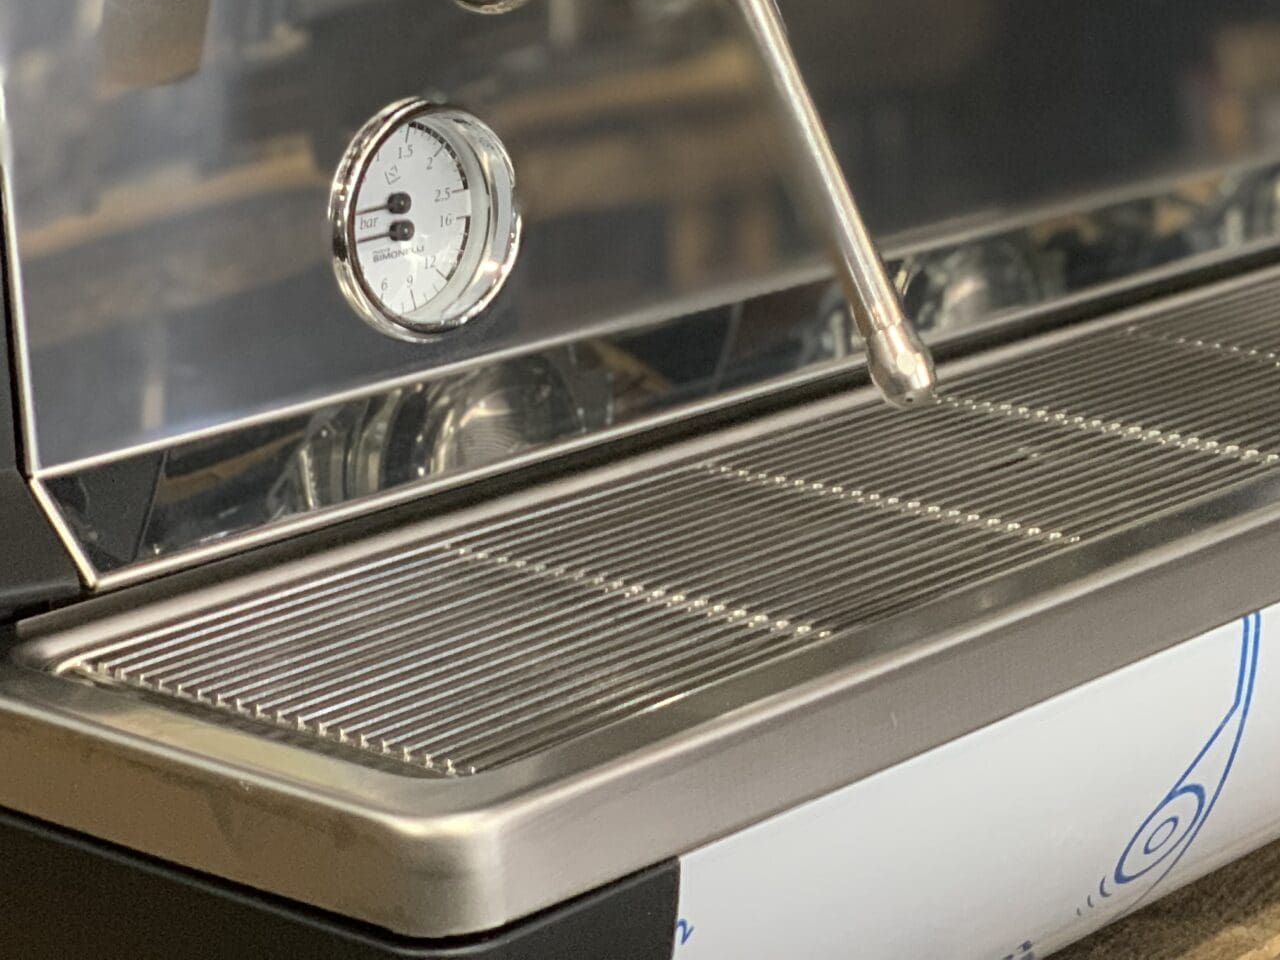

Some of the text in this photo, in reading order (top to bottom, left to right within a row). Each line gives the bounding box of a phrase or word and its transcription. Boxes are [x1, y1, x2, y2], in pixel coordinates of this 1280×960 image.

[398, 145, 414, 159] 1.5
[426, 157, 434, 170] 2
[434, 188, 451, 202] 2.5
[360, 217, 379, 231] bar
[439, 214, 453, 228] 16
[424, 256, 437, 270] 12
